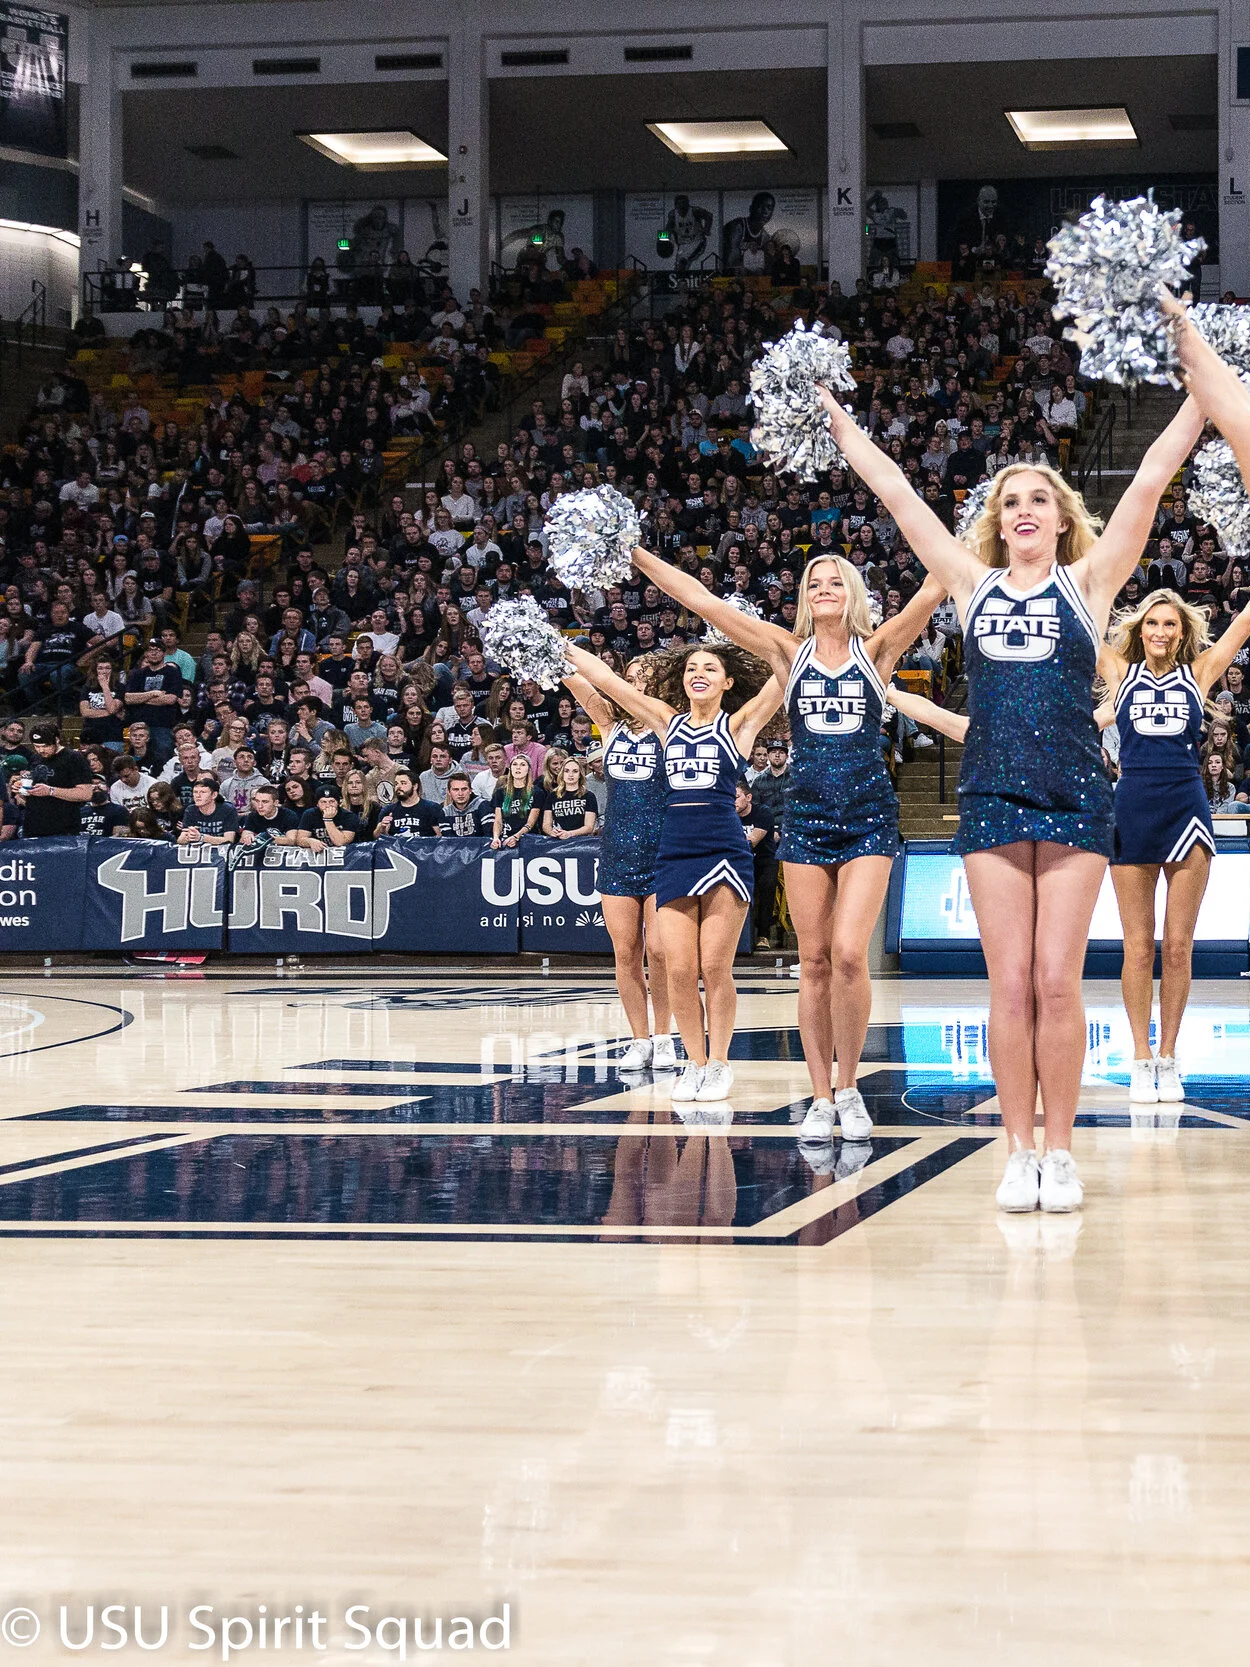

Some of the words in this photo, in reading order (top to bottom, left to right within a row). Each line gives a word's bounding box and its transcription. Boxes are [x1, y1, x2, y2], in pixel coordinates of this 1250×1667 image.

[1229, 177, 1243, 195] L
[837, 187, 853, 205] K
[456, 198, 469, 216] J
[86, 209, 100, 226] H
[973, 615, 1062, 640] STATE
[796, 696, 868, 718] STATE
[1128, 703, 1190, 721] STATE
[606, 751, 658, 769] STATE
[663, 758, 721, 777] STATE
[81, 815, 105, 825] UTAH
[394, 817, 420, 828] UTAH
[263, 845, 347, 867] STATE
[0, 859, 36, 882] dit
[480, 857, 603, 907] USU
[0, 889, 37, 907] on
